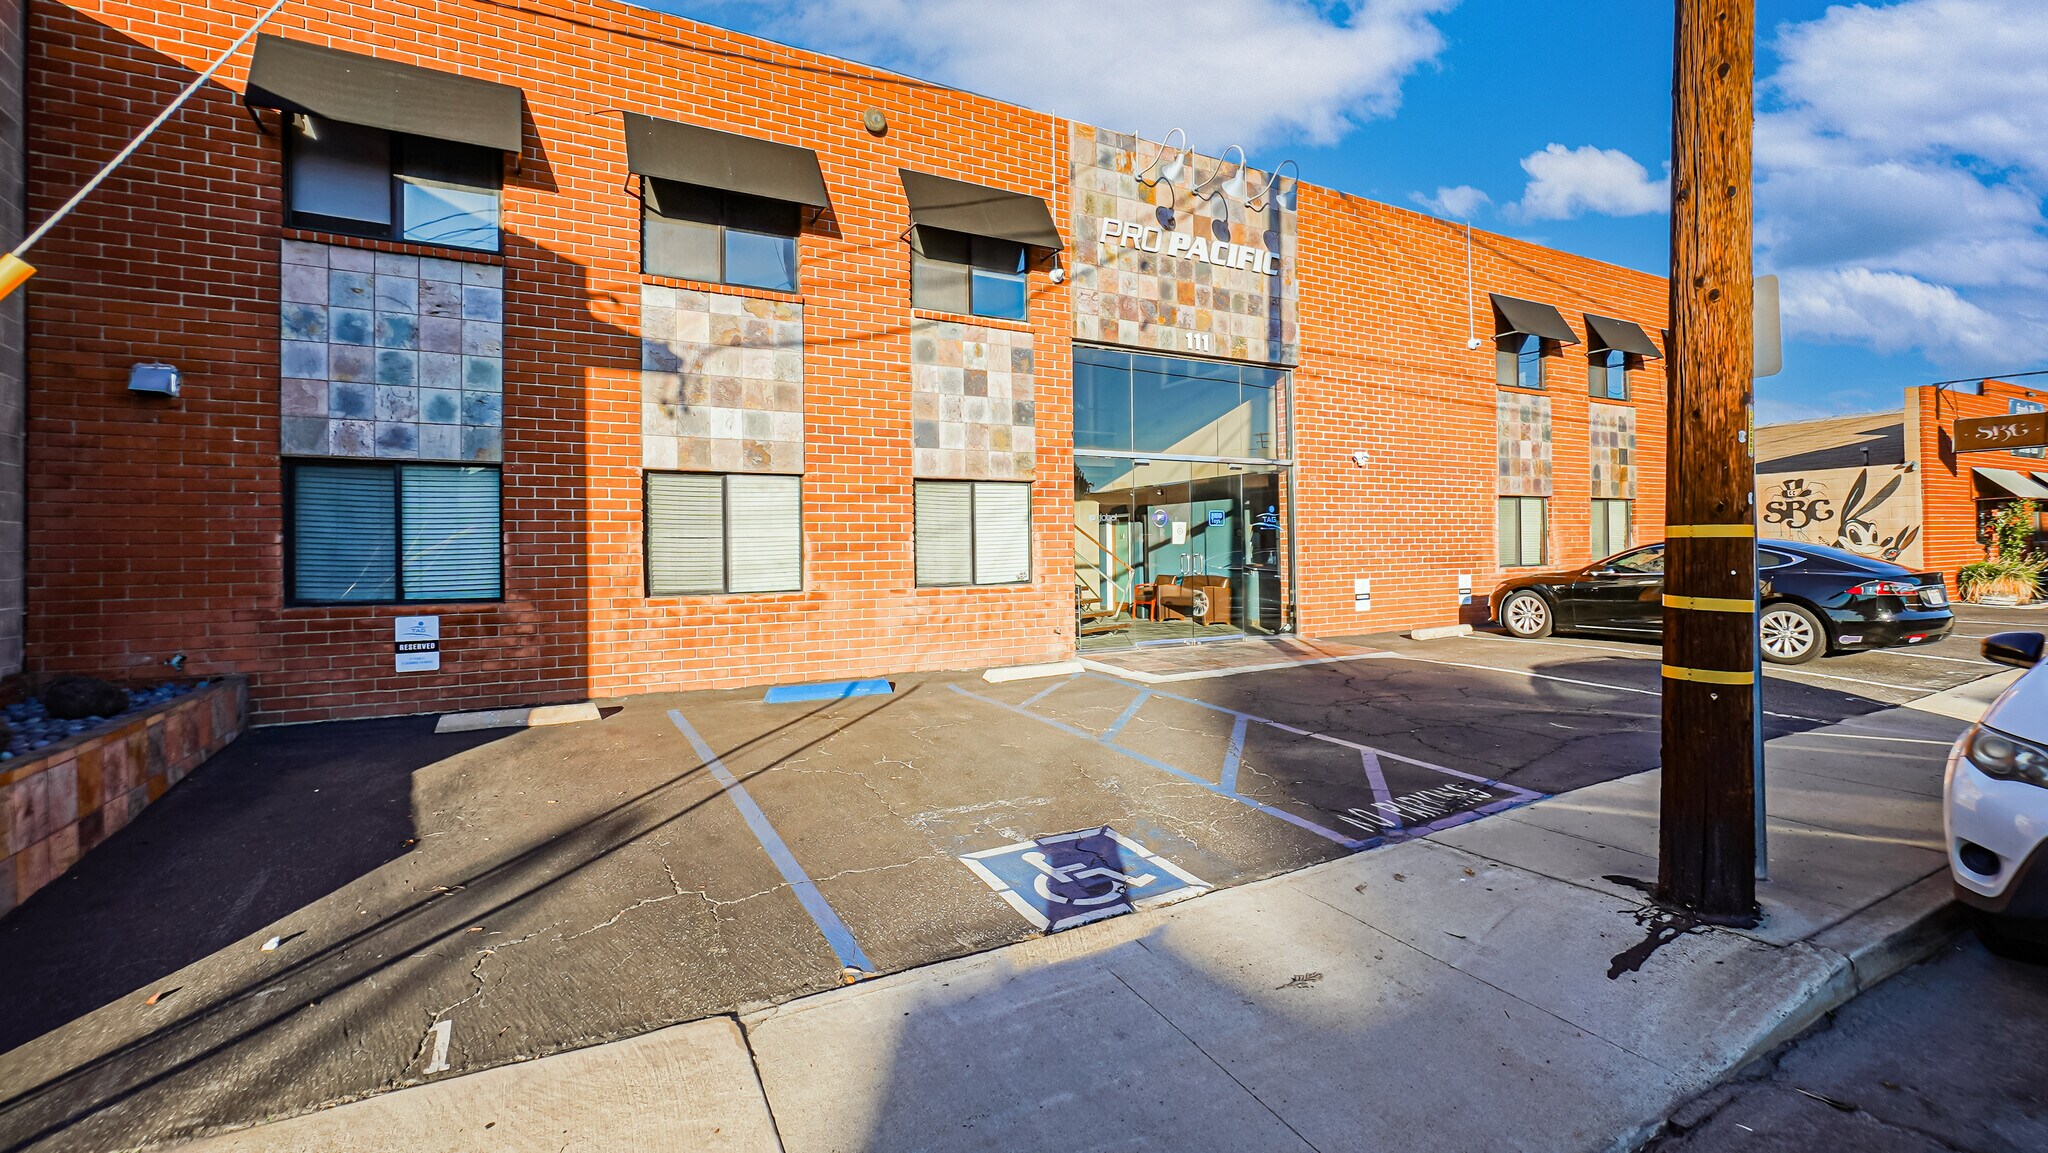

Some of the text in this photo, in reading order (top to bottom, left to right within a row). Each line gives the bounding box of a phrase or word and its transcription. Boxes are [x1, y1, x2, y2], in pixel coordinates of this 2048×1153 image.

[1100, 217, 1281, 276] PRO PACIFIC
[1185, 332, 1209, 352] 111
[399, 642, 435, 651] RESERVED
[1336, 782, 1492, 833] NO PARKING
[422, 1019, 453, 1075] 1
